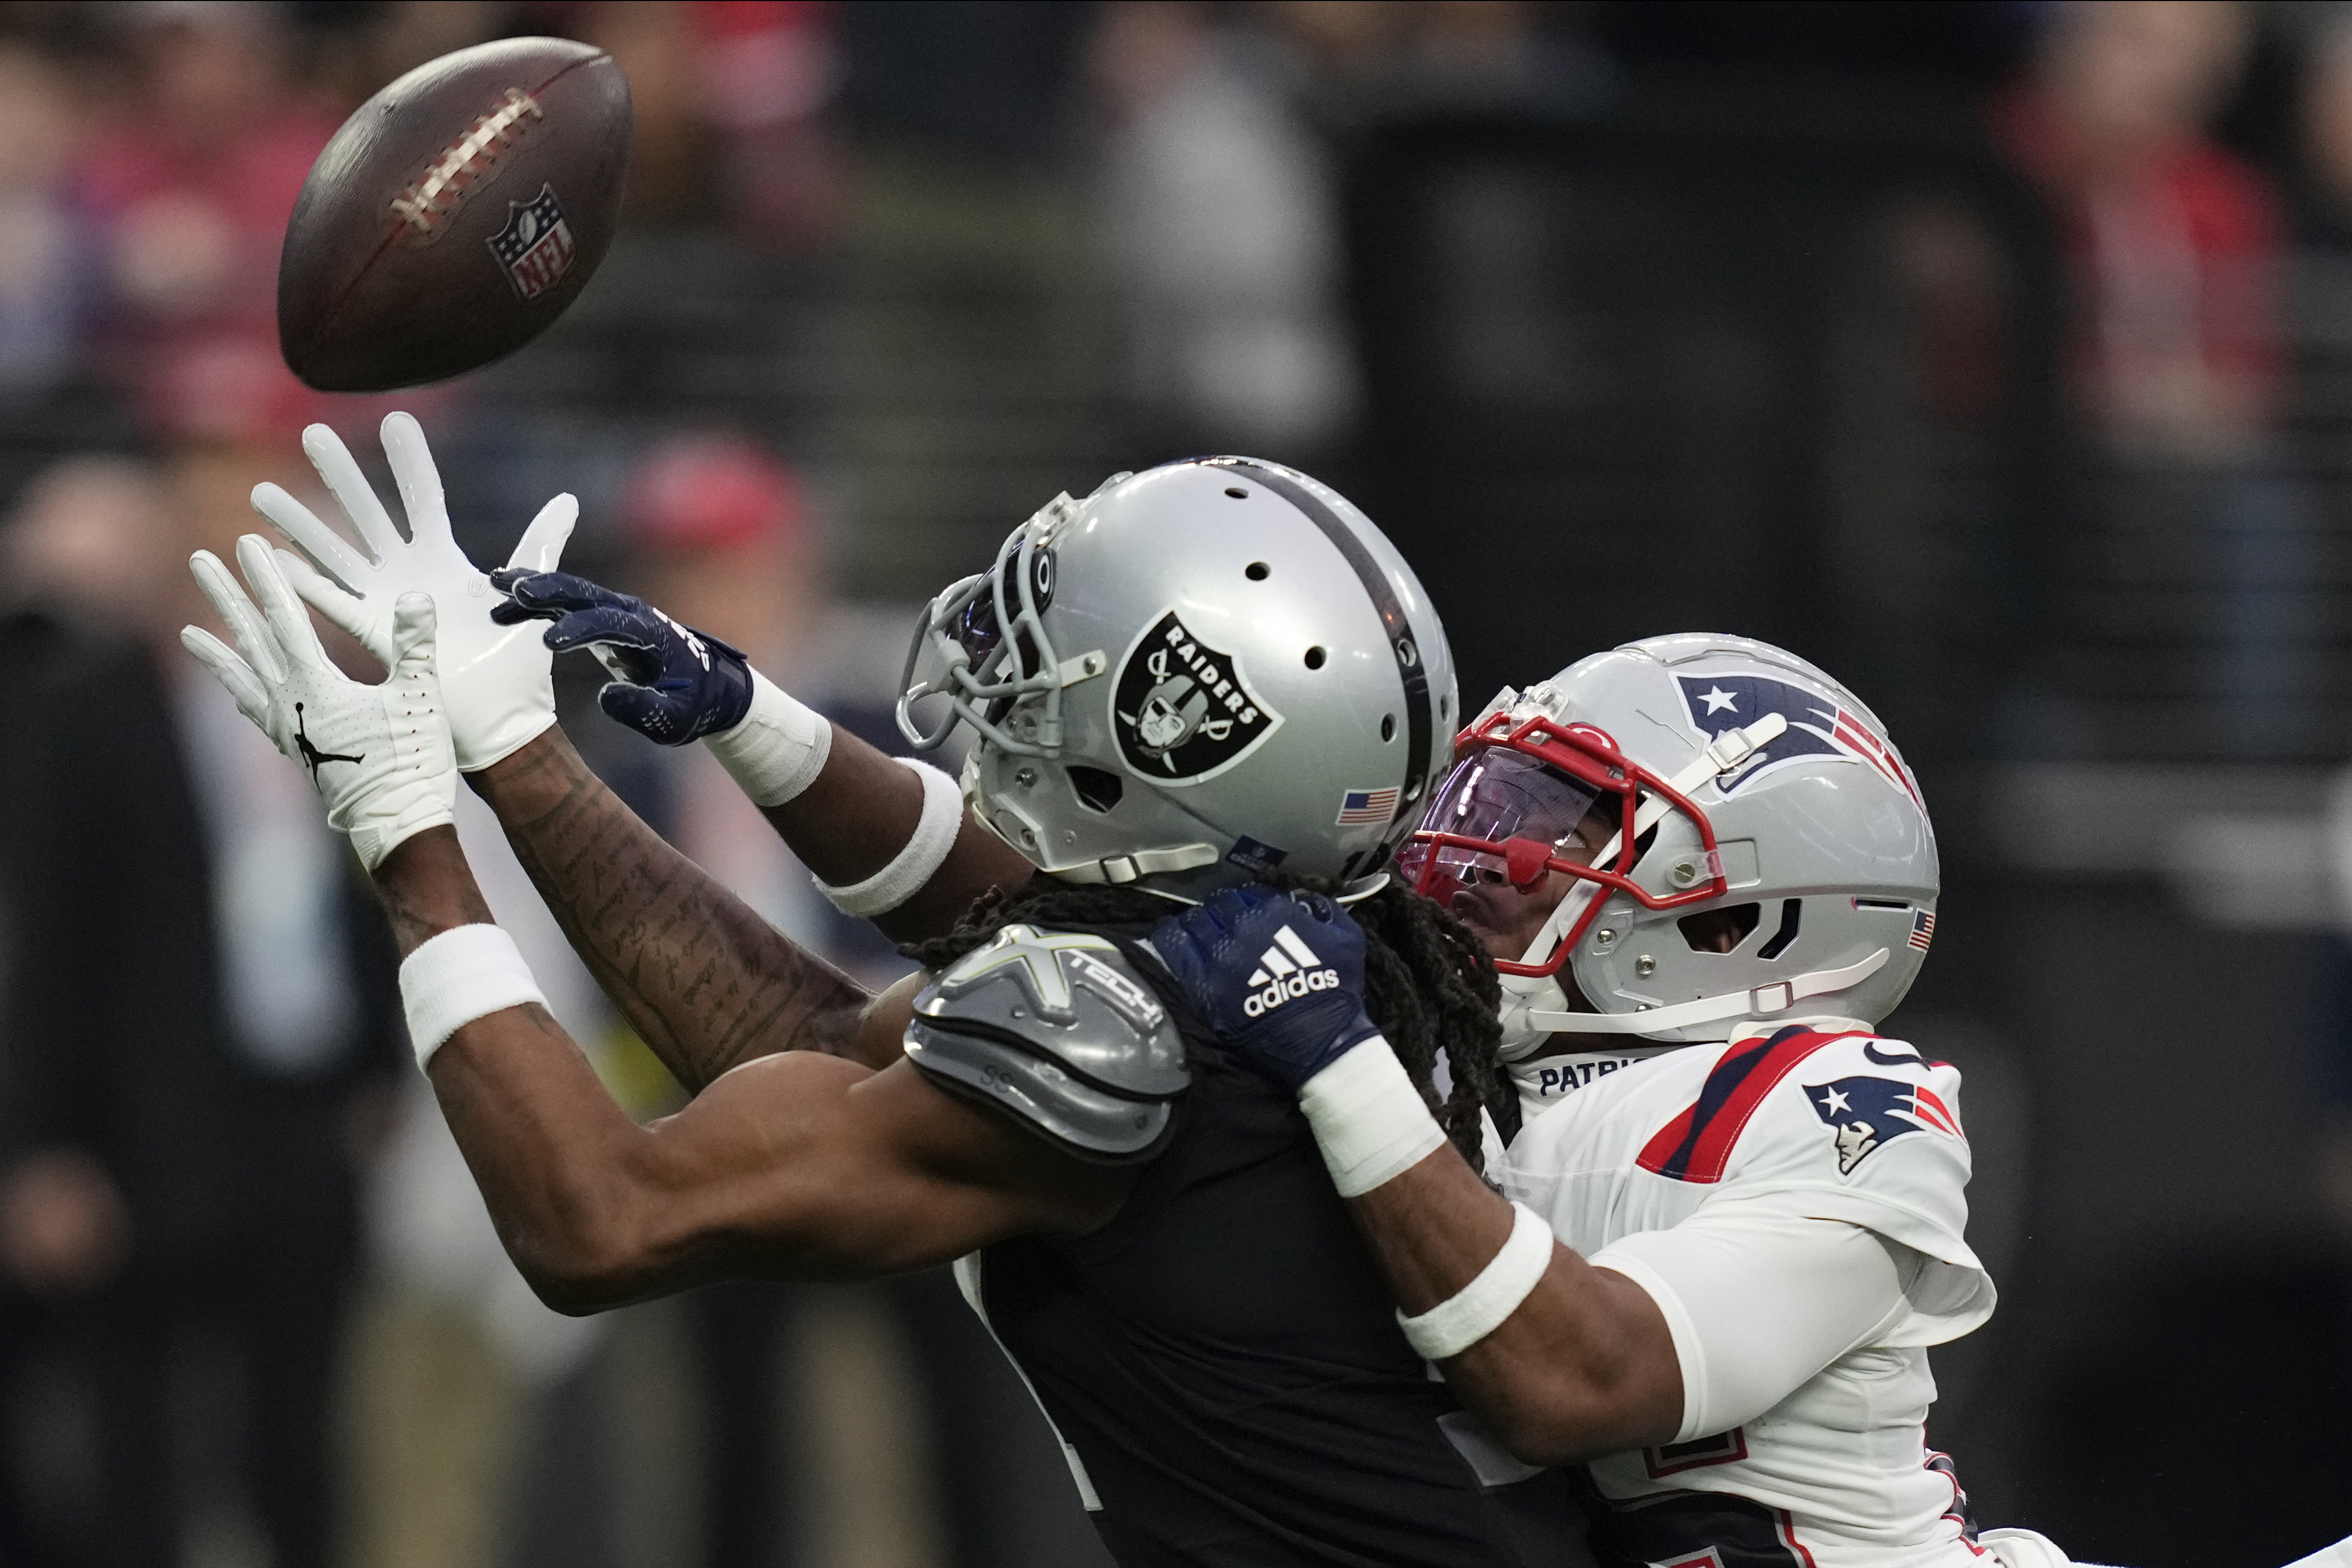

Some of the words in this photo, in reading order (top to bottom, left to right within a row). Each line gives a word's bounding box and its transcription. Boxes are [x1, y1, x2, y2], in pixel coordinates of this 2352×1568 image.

[513, 227, 576, 294] NFL
[1165, 625, 1258, 724] RAIDERS
[1243, 967, 1341, 1018] adidas
[1539, 1057, 1650, 1097] PATR
